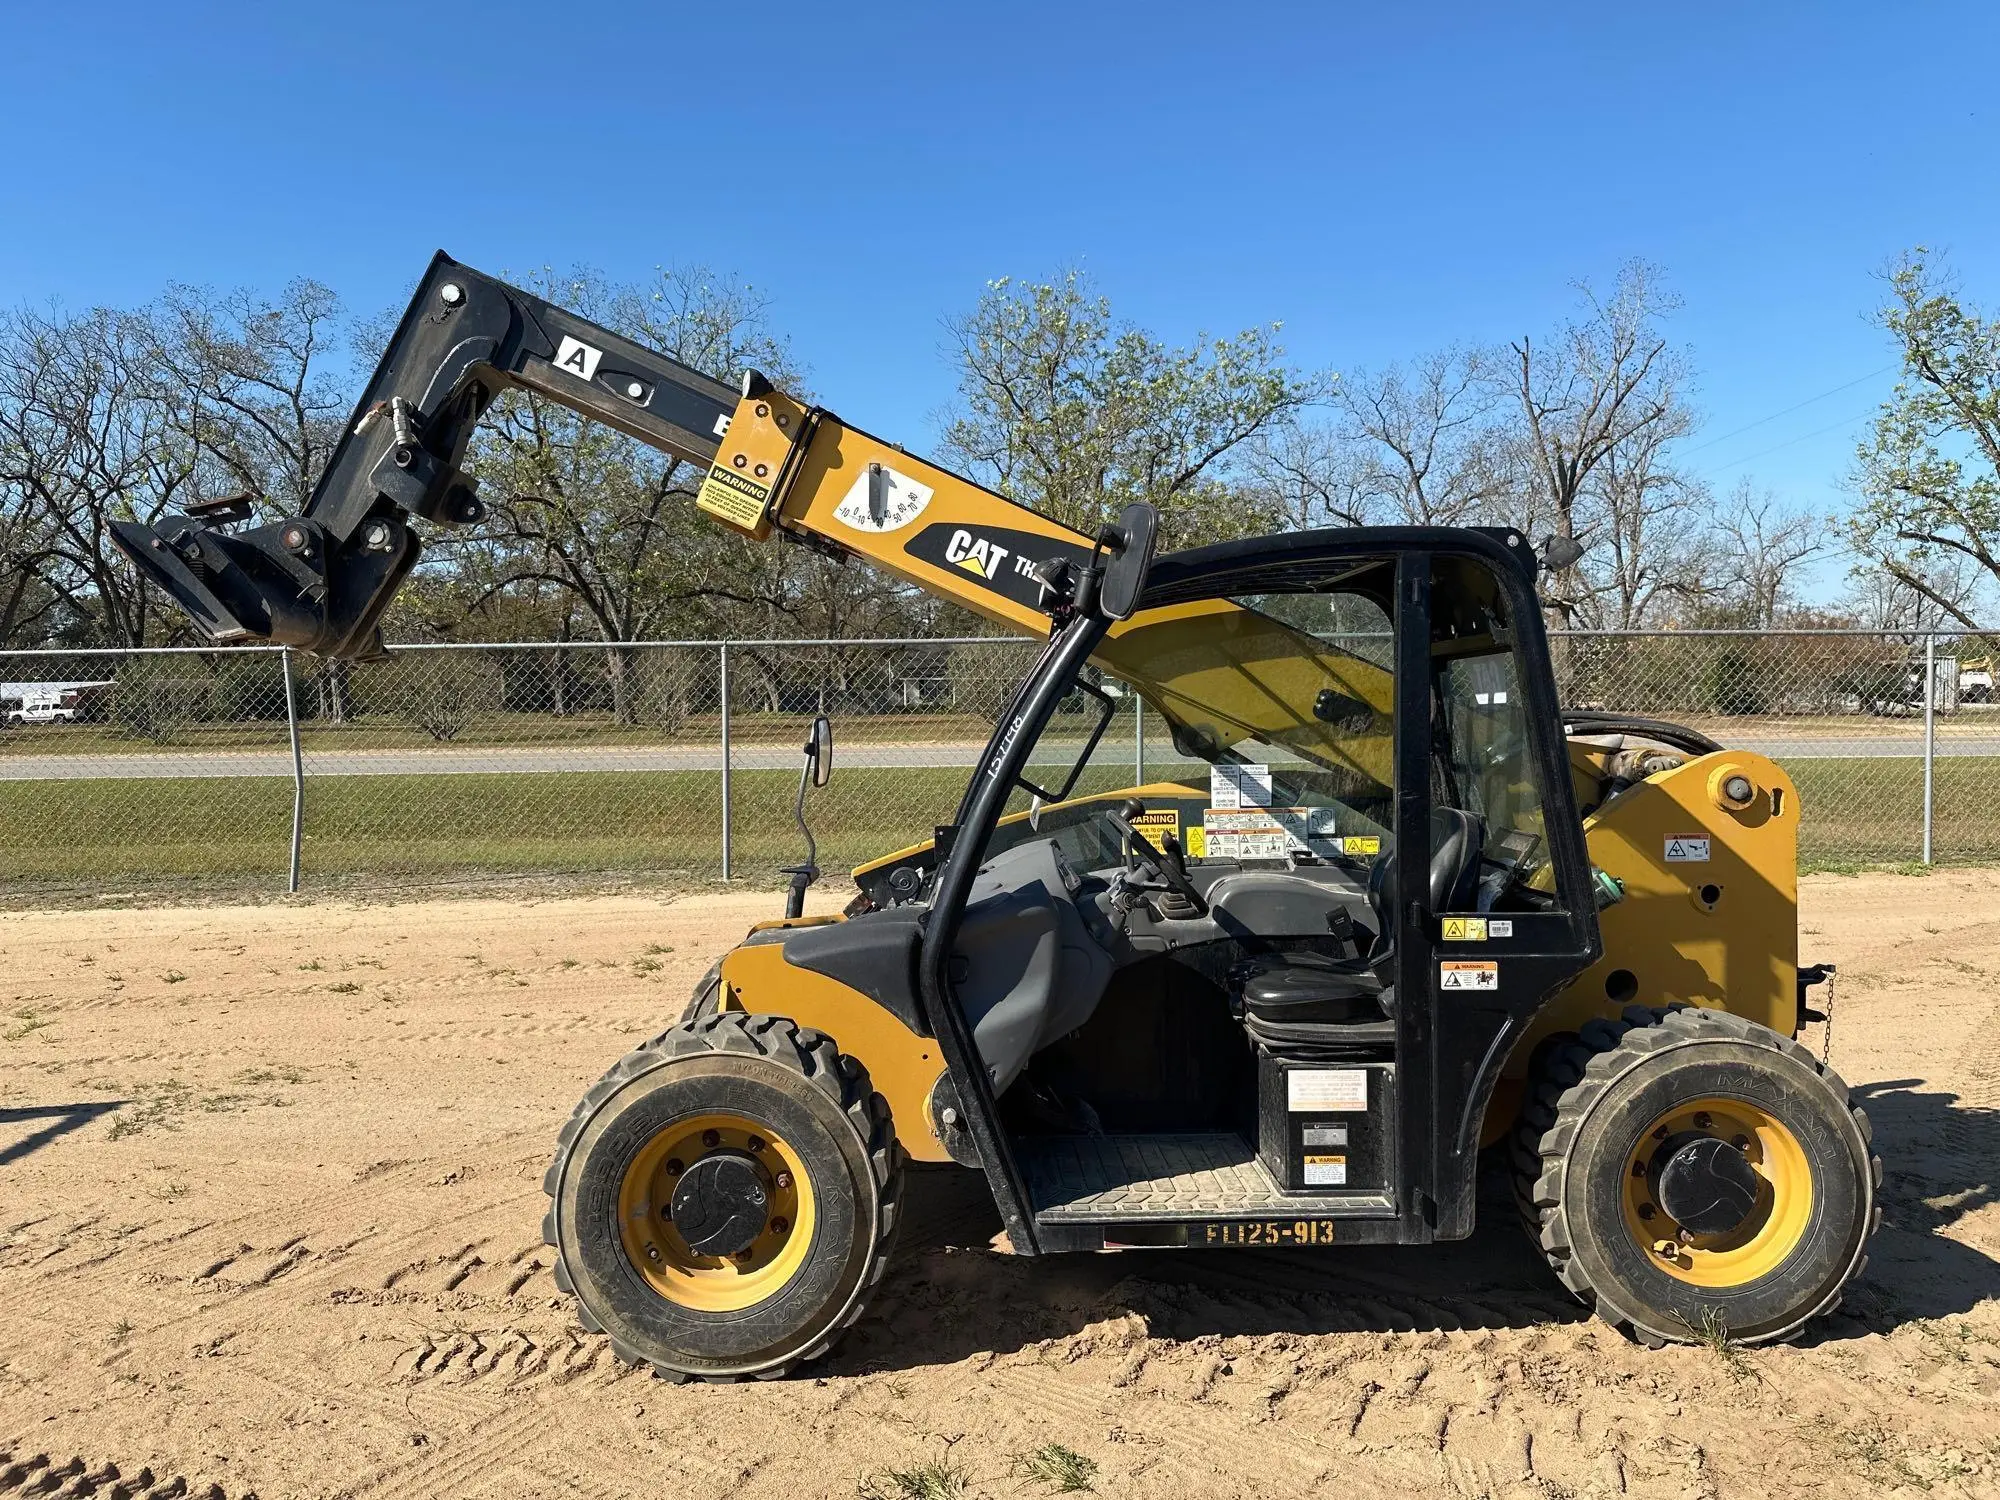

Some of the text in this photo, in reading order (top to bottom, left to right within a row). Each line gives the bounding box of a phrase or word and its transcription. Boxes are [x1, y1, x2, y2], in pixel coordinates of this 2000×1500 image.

[563, 347, 586, 374] A
[708, 483, 732, 497] UNLAWFUL
[740, 498, 760, 511] OPERATE
[713, 469, 766, 499] WARNING
[715, 492, 742, 507] EQUIPMENT
[907, 502, 918, 512] 70
[857, 515, 866, 525] 10
[945, 529, 1043, 583] CAT TH
